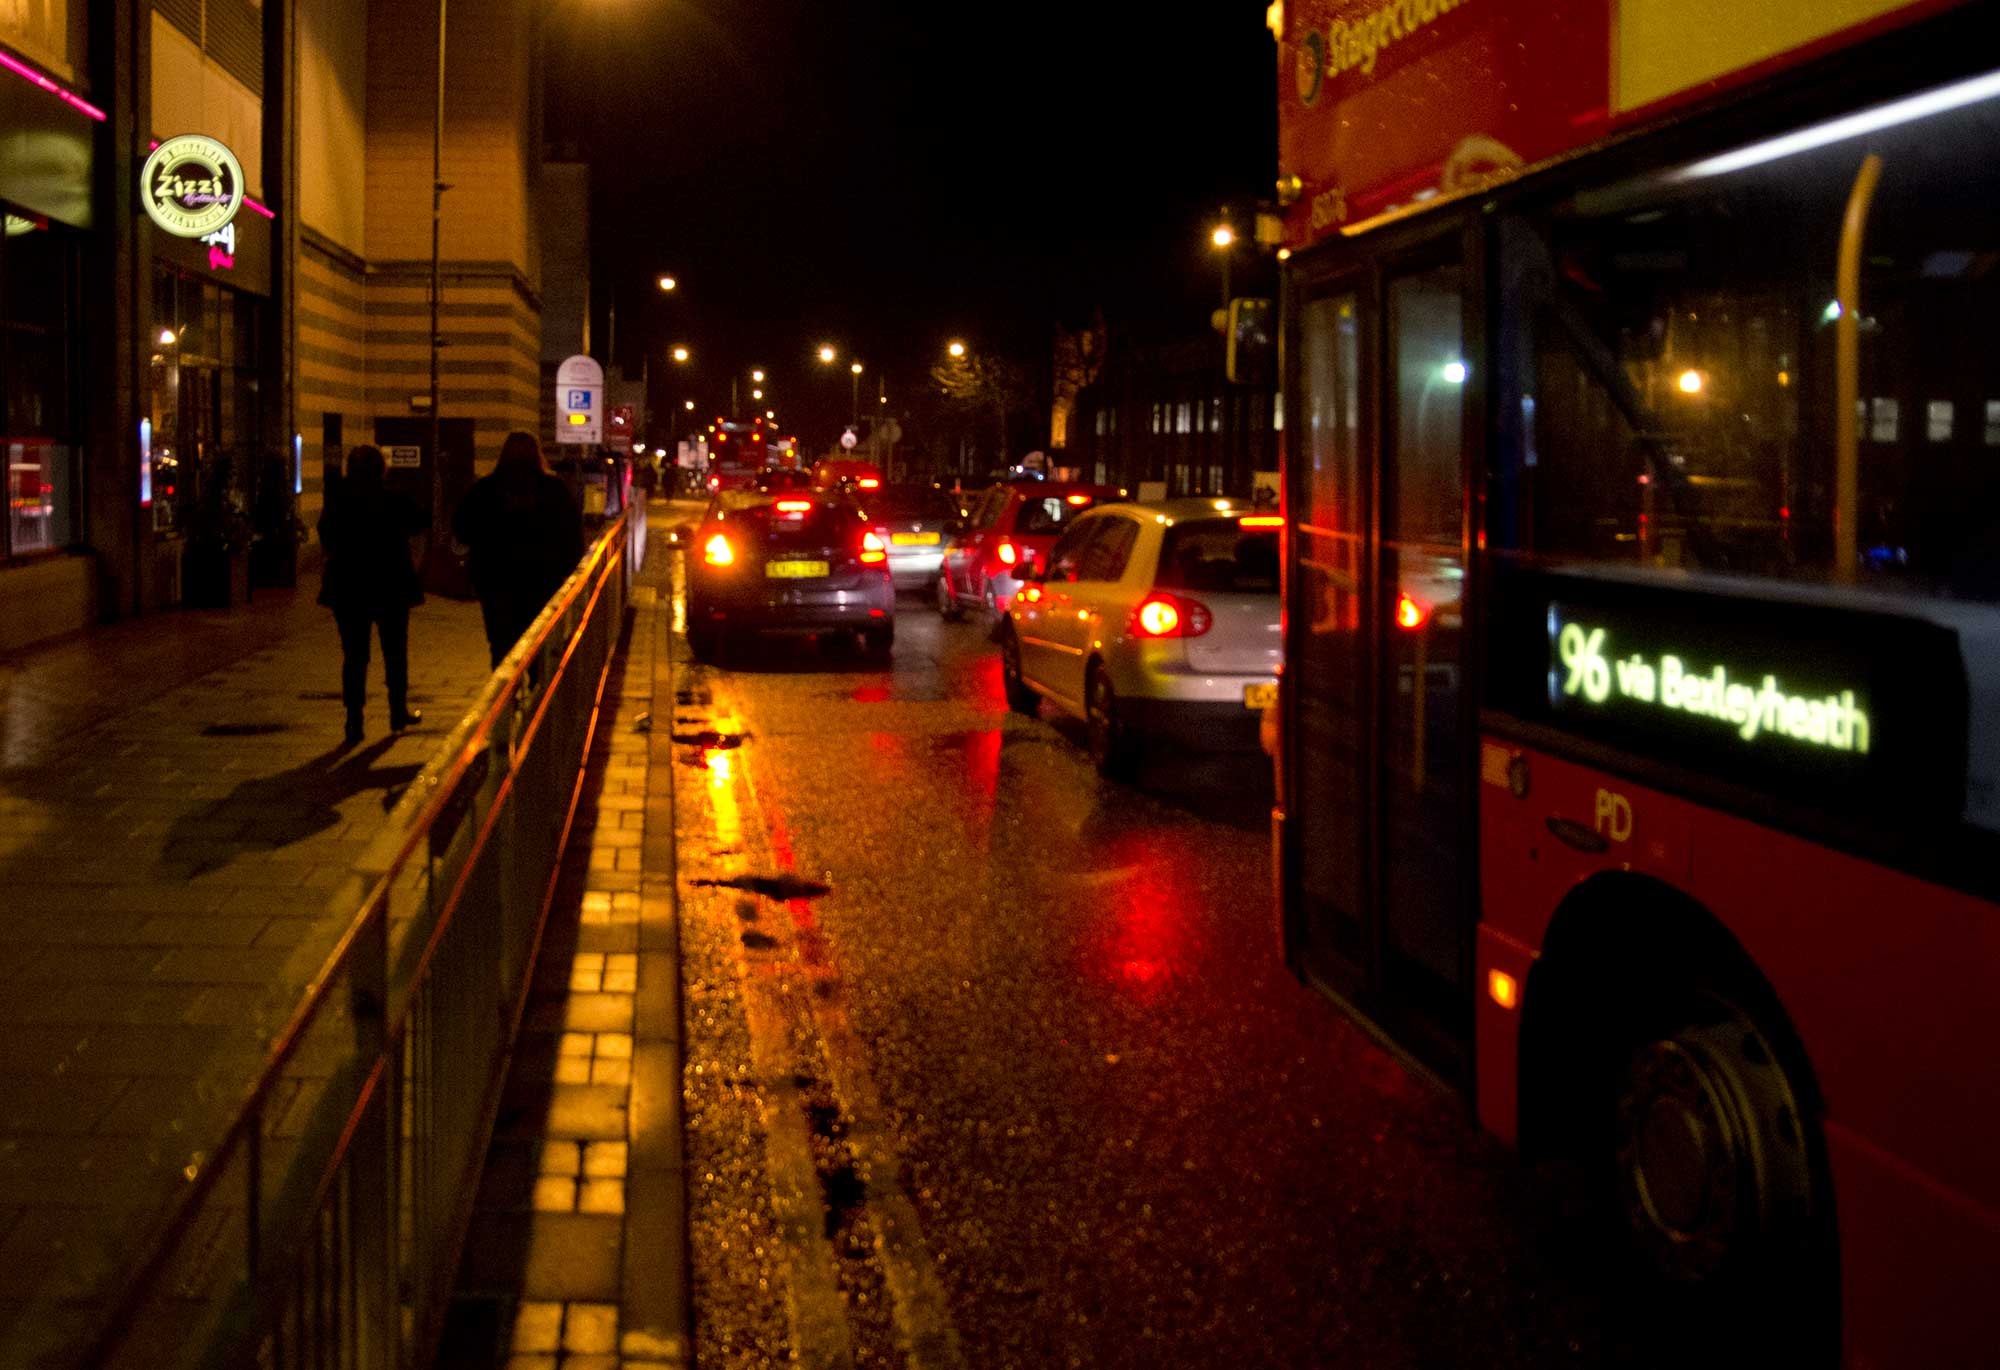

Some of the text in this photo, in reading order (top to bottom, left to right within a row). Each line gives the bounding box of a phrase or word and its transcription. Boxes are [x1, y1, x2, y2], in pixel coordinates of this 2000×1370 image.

[155, 174, 223, 197] Zizzi
[1560, 623, 1868, 754] 96 via Bexleyheath
[1595, 788, 1632, 841] PD
